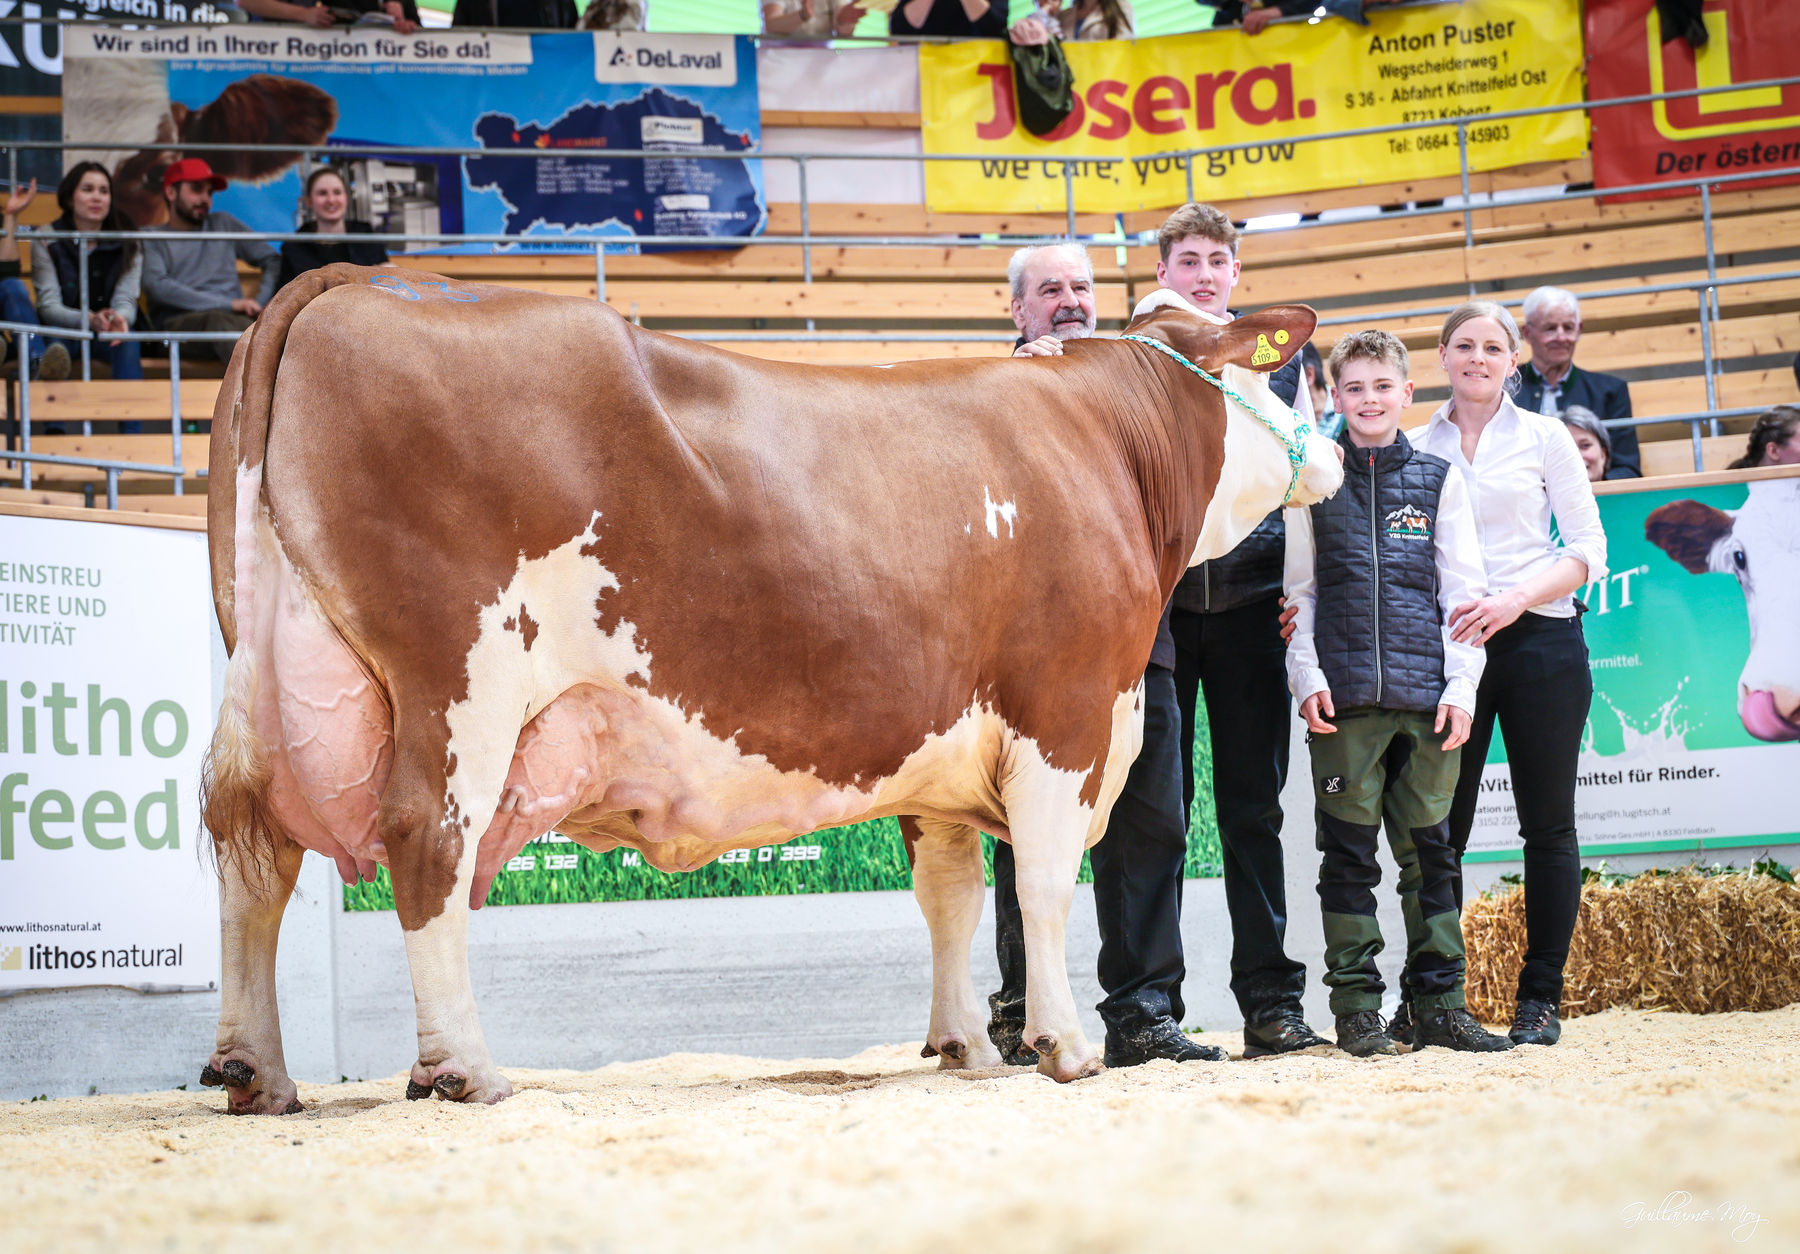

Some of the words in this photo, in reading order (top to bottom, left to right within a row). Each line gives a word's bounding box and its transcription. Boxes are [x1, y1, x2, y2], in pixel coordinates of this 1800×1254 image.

[93, 34, 133, 52] Wir
[141, 36, 189, 54] sind
[198, 36, 217, 54] in
[225, 35, 279, 55] Ihrer
[287, 37, 368, 59] Region
[376, 39, 406, 57] für
[414, 41, 449, 58] Sie
[456, 41, 491, 59] da!
[1368, 32, 1436, 55] Anton
[1444, 20, 1516, 46] Puster
[637, 48, 722, 69] DeLaval
[1378, 54, 1499, 80] Wegscheiderweg
[1502, 50, 1508, 64] 1
[1345, 93, 1355, 109] S
[1358, 92, 1375, 108] 36
[1391, 84, 1443, 104] Abfahrt
[1447, 77, 1518, 98] Knittelfeld
[1521, 69, 1547, 86] Ost
[1388, 138, 1412, 154] Tel:
[1416, 132, 1449, 151] 0664
[982, 158, 1029, 179] we
[1207, 142, 1296, 178] grow
[1656, 152, 1706, 175] Der
[0, 562, 102, 588] EINSTREU
[57, 596, 107, 617] UND
[0, 621, 77, 645] TIVITÄT
[0, 680, 189, 758] litho
[1629, 769, 1653, 784] für
[1658, 765, 1721, 781] Rinder.
[0, 772, 181, 860] feed
[544, 854, 579, 870] 132
[622, 852, 642, 867] M.
[779, 845, 821, 861] 399
[0, 922, 101, 933] www.lithosnatural.at
[29, 943, 97, 970] lithos
[102, 943, 183, 968] natural
